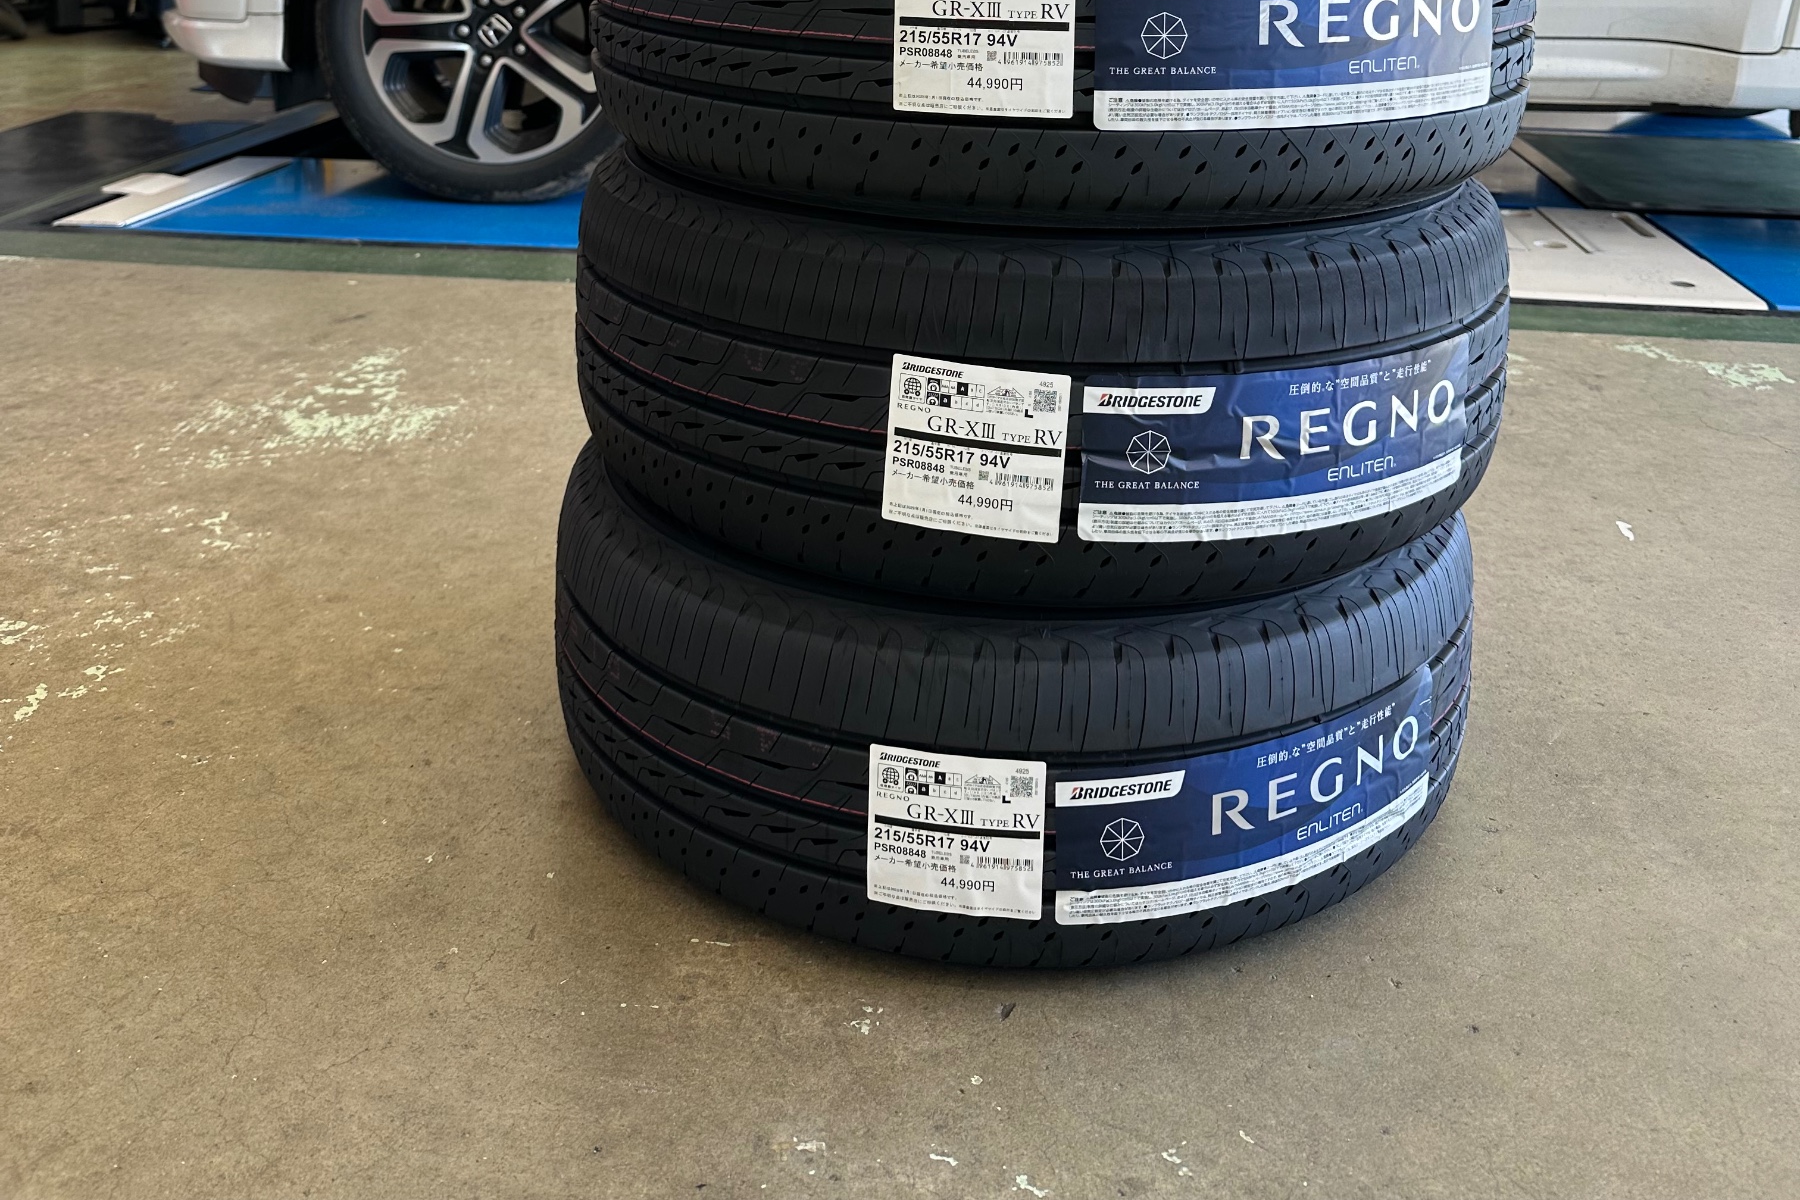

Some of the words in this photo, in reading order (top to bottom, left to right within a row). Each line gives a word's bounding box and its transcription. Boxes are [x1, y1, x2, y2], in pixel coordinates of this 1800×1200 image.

[1007, 9, 1038, 19] TYPE
[1041, 3, 1070, 19] RV
[899, 29, 982, 46] 215/55R17
[986, 33, 1018, 47] 94V
[899, 46, 953, 58] PSR08848
[899, 60, 984, 72] メーカー希望小売価格
[1109, 66, 1130, 75] THE
[1133, 66, 1166, 75] GREAT
[1170, 66, 1217, 75] BALANCE
[1349, 55, 1417, 75] ENLITEN
[967, 77, 1023, 91] 44,990円
[901, 361, 965, 379] BRIDGESTONE
[897, 402, 931, 414] REGNO
[1098, 393, 1202, 408] BRIDGESTONE
[1239, 379, 1455, 461] REGNO
[1001, 432, 1031, 444] TYPE
[1034, 428, 1063, 447] RV
[893, 440, 975, 465] 215/55R17
[979, 454, 1011, 469] 94V
[892, 456, 945, 473] PSR08848
[1327, 456, 1394, 482] ENLITEN
[892, 470, 975, 490] メーカー希望小売価格
[1094, 480, 1114, 489] THE
[1118, 481, 1150, 490] GREAT
[1154, 481, 1200, 489] BALANCE
[957, 494, 1013, 512] 44,990円
[879, 752, 941, 768] BRIDGESTONE
[1211, 715, 1419, 836] REGNO
[876, 791, 910, 802] REGNO
[1069, 779, 1173, 801] BRIDGESTONE
[980, 818, 1009, 828] TYPE
[1013, 813, 1040, 829] RV
[1297, 802, 1361, 841] ENLITEN
[874, 827, 955, 850] 215/55R17
[960, 839, 990, 853] 94V
[874, 842, 926, 859] PSR08848
[874, 854, 957, 873] メーカー希望小売価格
[1070, 870, 1090, 879] THE
[1093, 867, 1125, 878] GREAT
[1128, 861, 1173, 874] BALANCE
[940, 877, 995, 892] 44,990円
